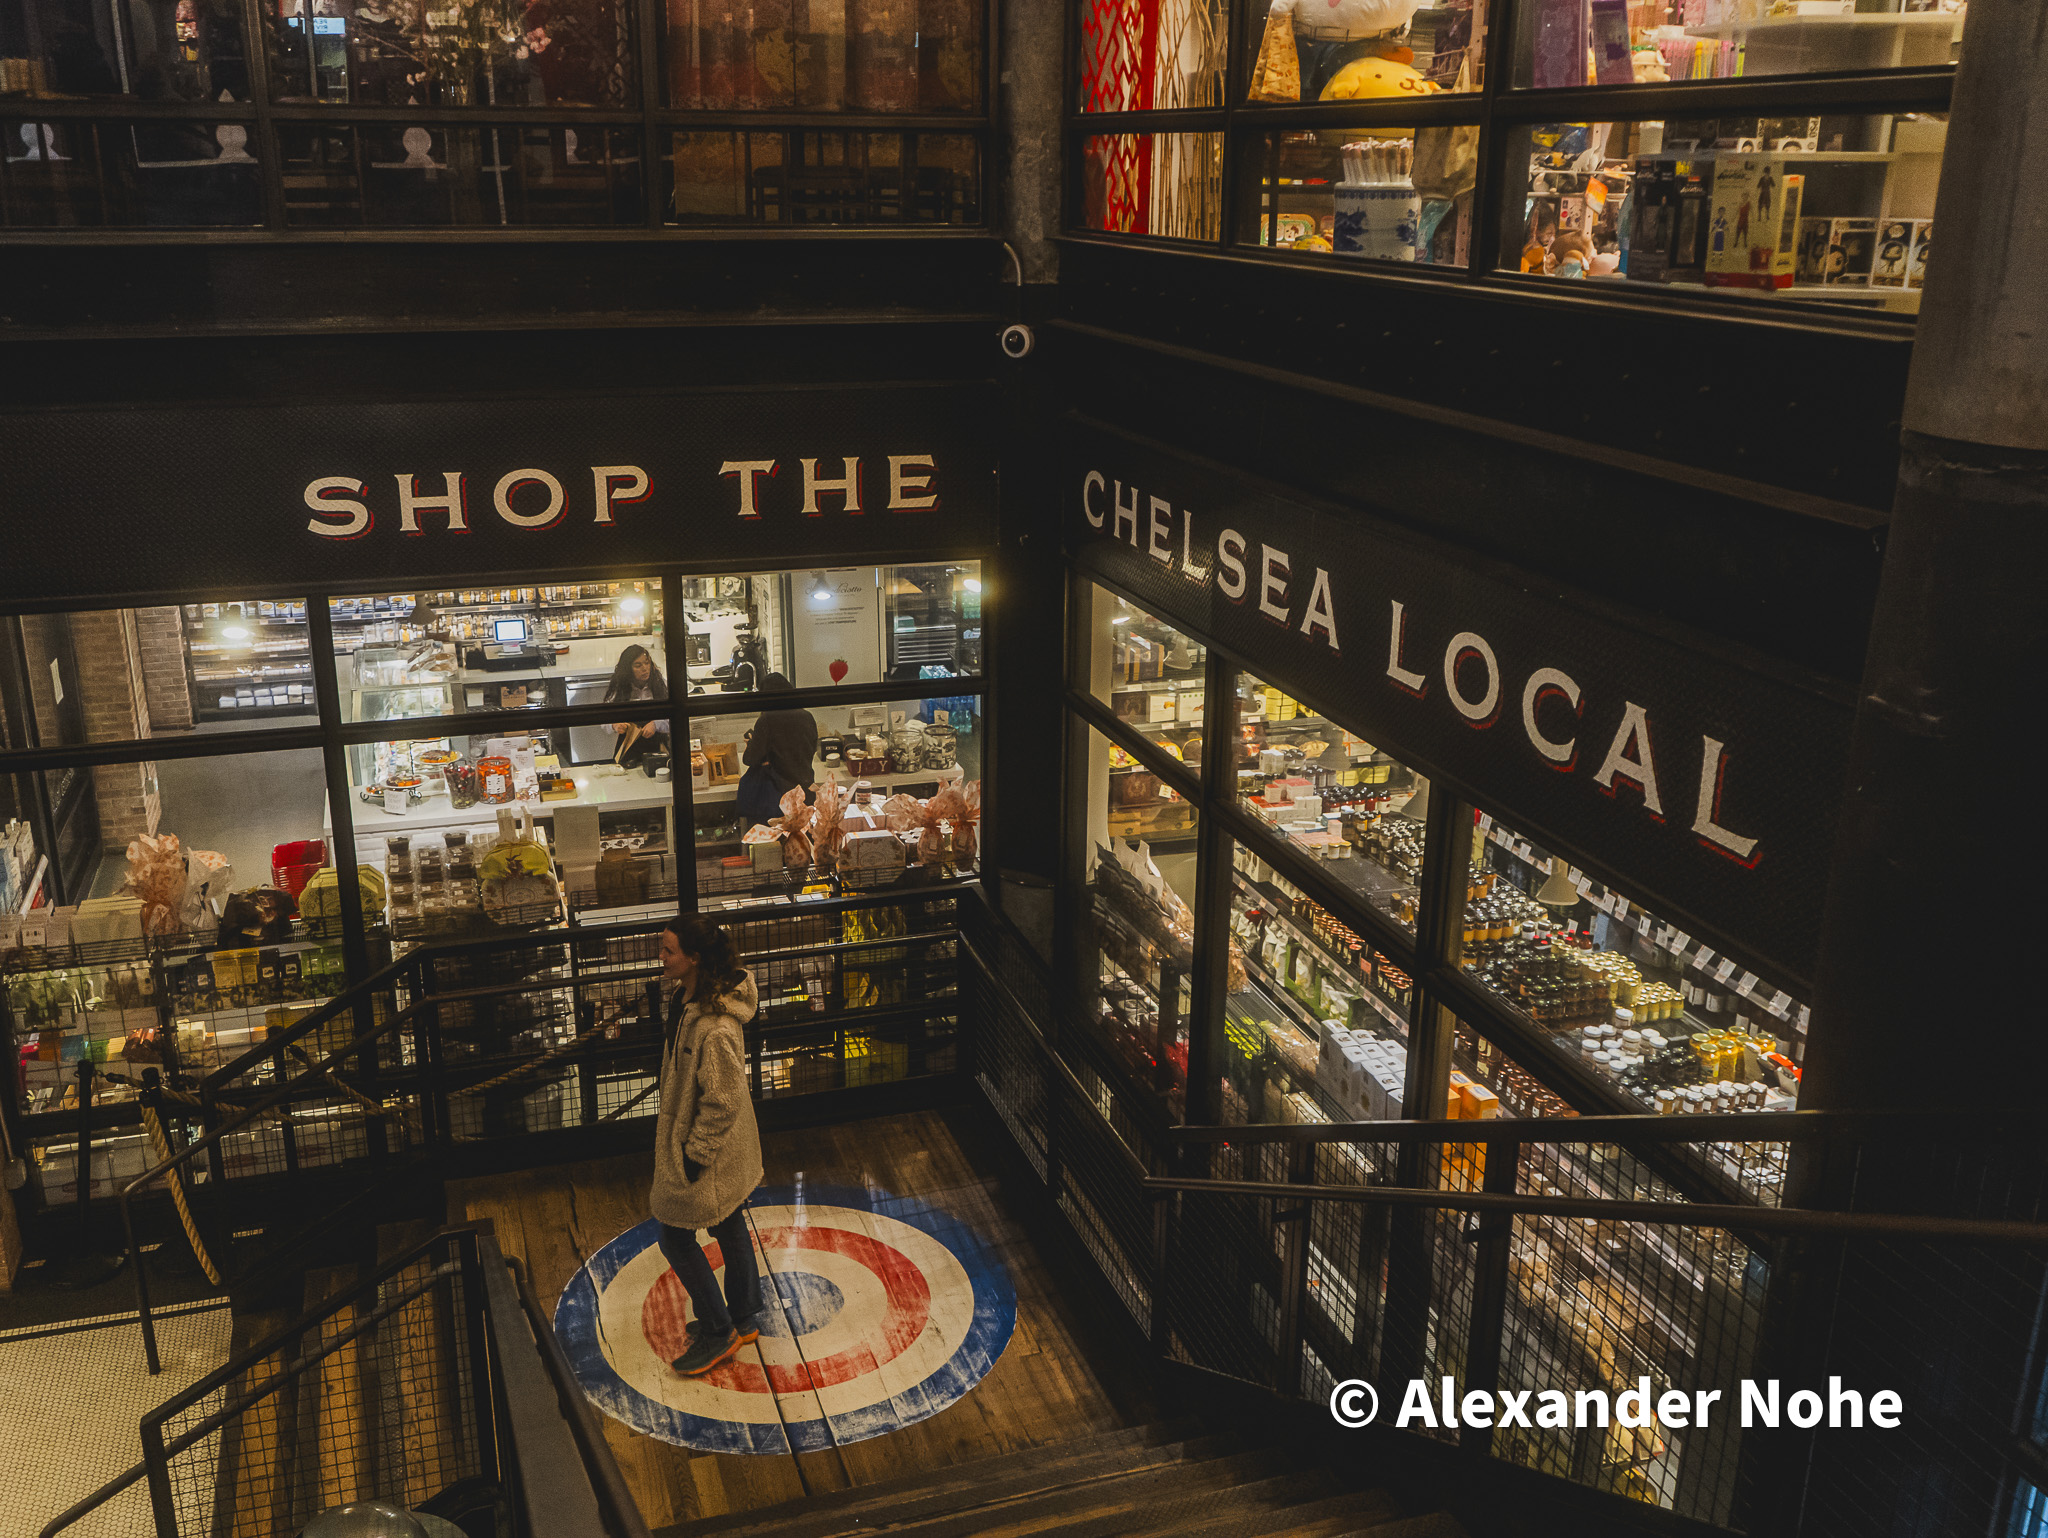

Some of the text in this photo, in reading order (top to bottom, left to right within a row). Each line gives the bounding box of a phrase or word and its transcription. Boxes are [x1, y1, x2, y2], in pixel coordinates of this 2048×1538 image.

[304, 455, 940, 538] SHOP THE
[1083, 470, 1762, 866] CHELSEA LOCAL
